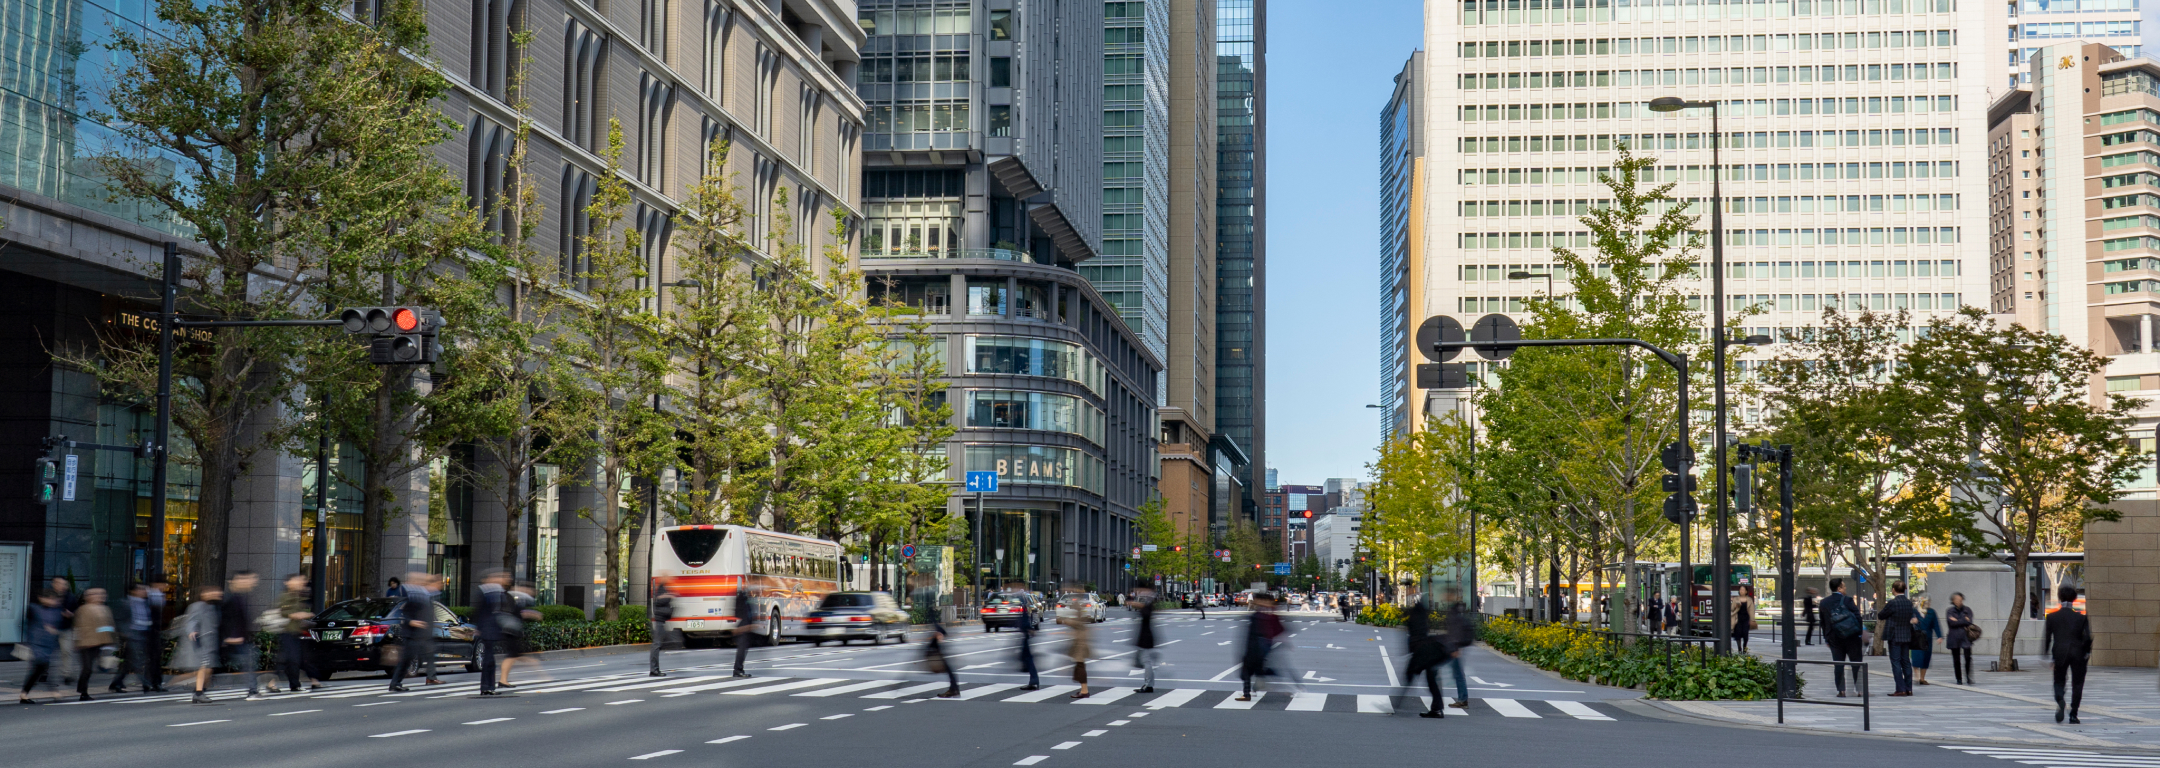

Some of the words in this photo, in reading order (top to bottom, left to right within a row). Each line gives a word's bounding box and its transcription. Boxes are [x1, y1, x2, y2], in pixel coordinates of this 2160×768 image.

[121, 312, 140, 327] THE
[143, 317, 187, 338] COAN
[190, 327, 213, 342] SHOP
[996, 459, 1062, 478] BEAMS
